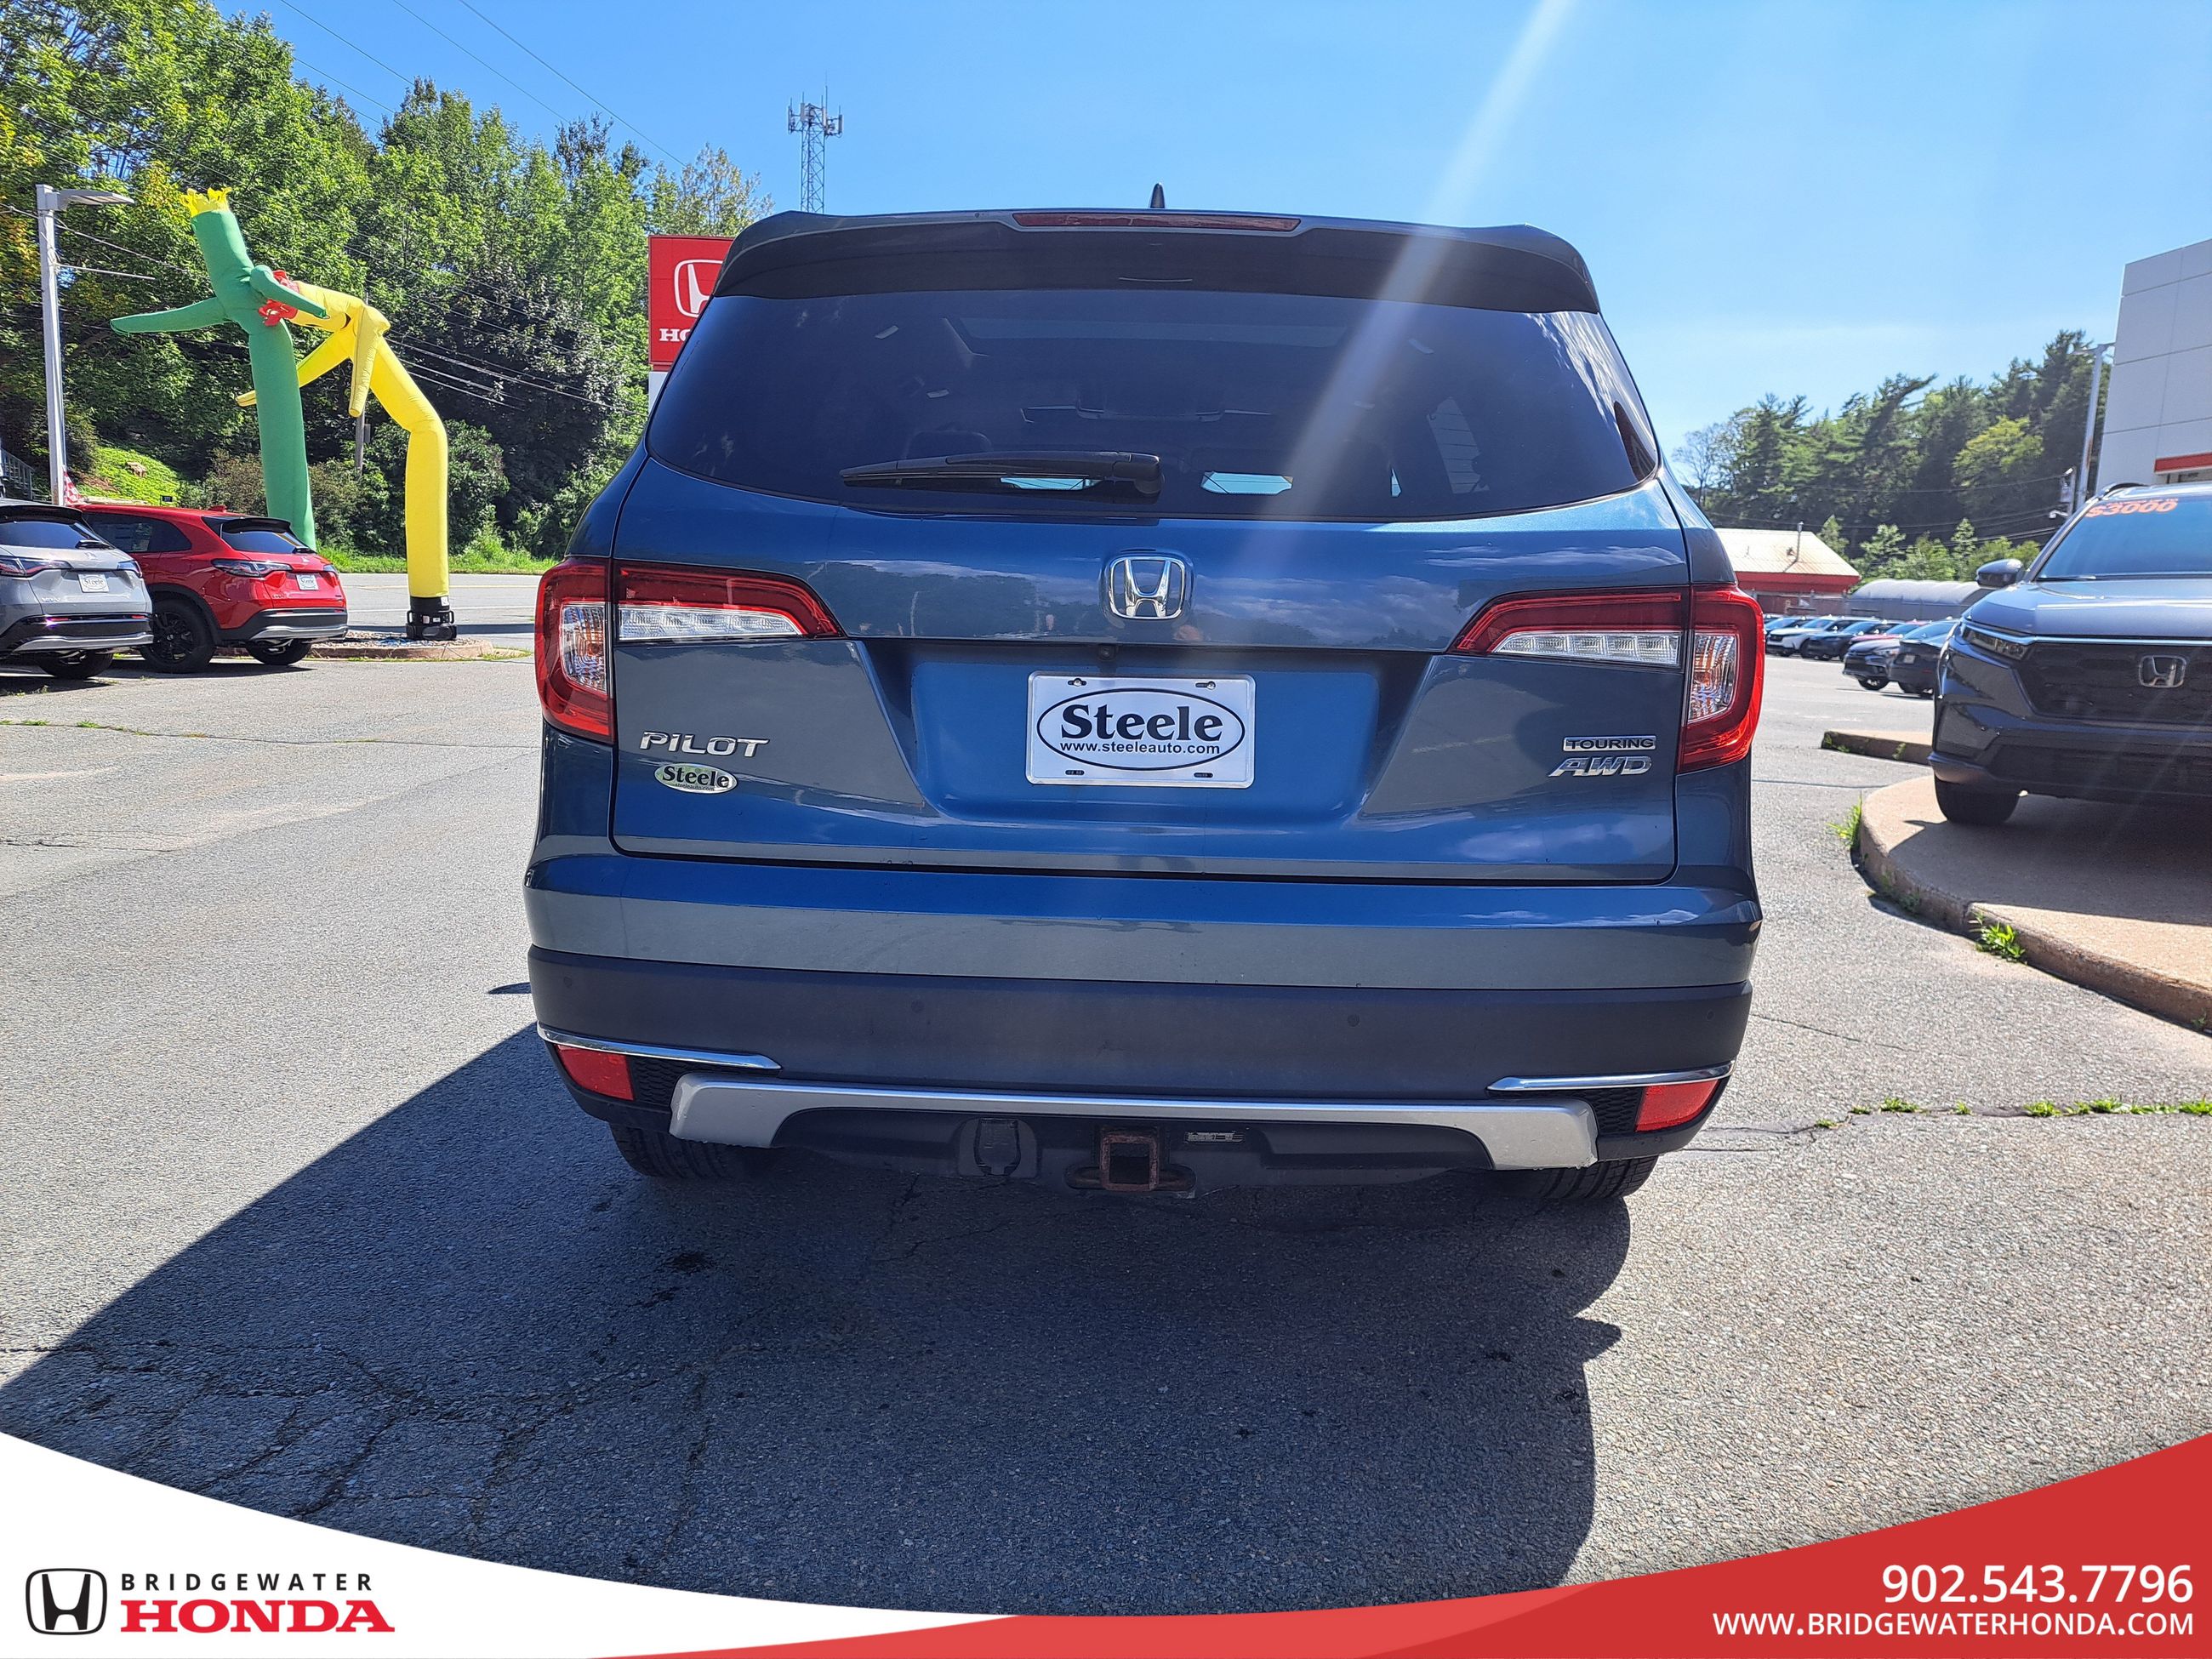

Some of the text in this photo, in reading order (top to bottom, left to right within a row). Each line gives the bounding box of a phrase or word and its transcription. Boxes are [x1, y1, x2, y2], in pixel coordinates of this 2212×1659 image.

[1061, 704, 1223, 741] Steele
[640, 731, 770, 758] PILOT
[1060, 742, 1220, 754] www.steeleauto.com
[1568, 738, 1654, 750] TOURING
[1548, 755, 1652, 777] AWD
[663, 767, 729, 788] Steele
